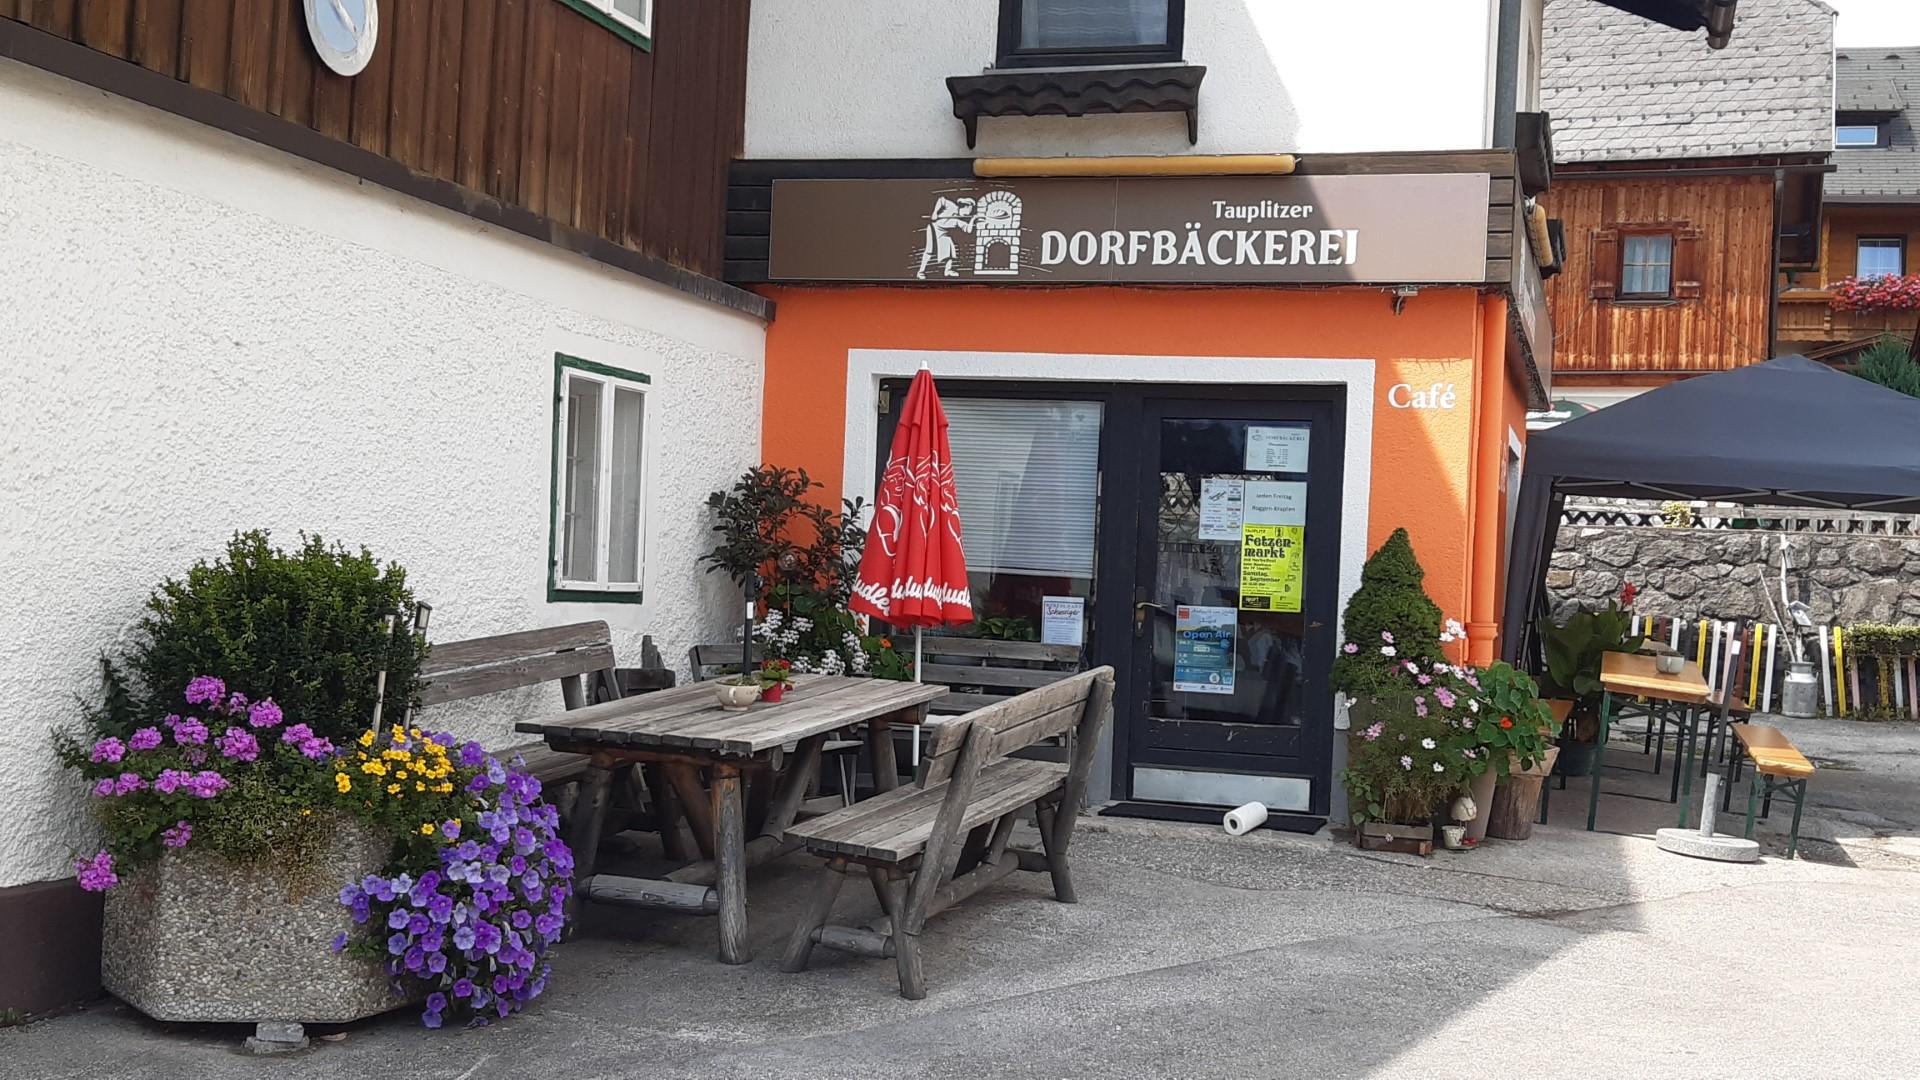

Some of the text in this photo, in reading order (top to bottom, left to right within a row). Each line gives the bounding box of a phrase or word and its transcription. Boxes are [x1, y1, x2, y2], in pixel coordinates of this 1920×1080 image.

[1212, 200, 1313, 223] Tauplitzer
[1040, 222, 1360, 266] DORFBÄCKEREI
[1388, 382, 1456, 409] Café
[1244, 534, 1296, 548] Fetzen-
[1243, 547, 1286, 559] markt
[1183, 630, 1233, 640] Open Air
